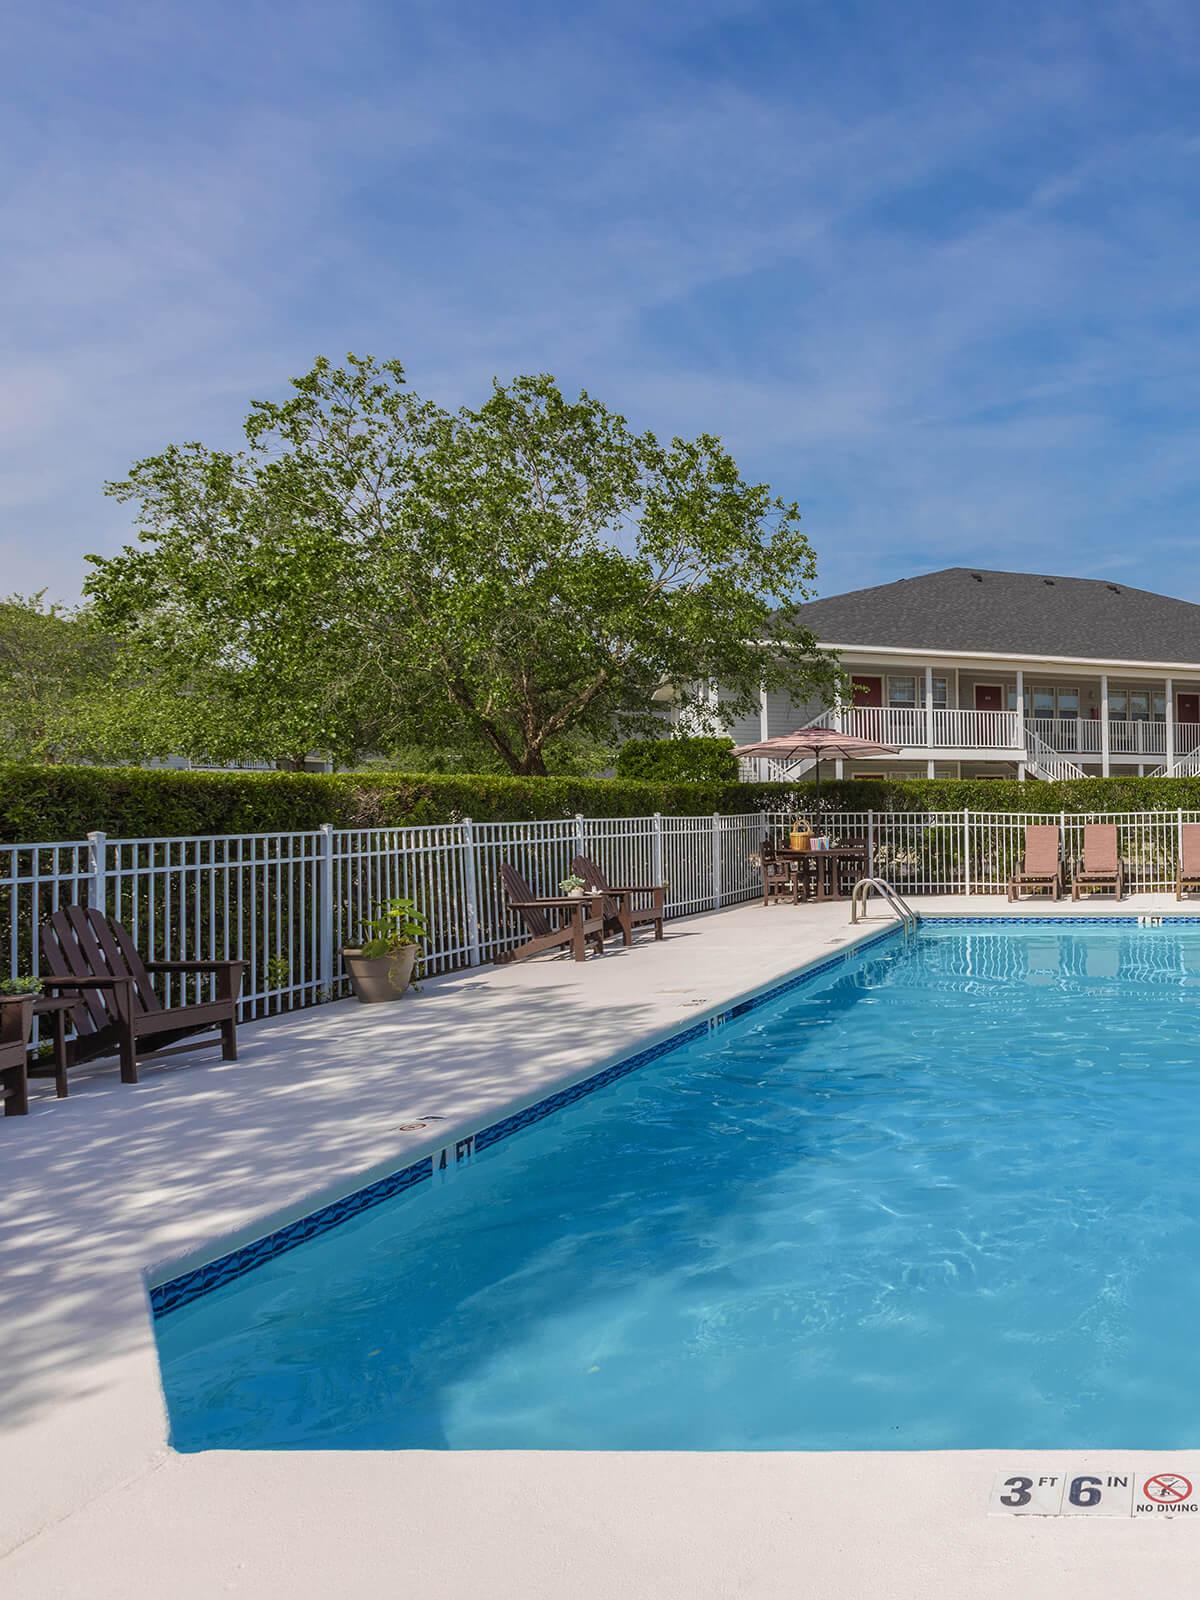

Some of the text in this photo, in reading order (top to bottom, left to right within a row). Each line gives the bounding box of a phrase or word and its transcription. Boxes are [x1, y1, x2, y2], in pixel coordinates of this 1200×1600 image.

[456, 1135, 475, 1162] FT
[999, 1475, 1129, 1508] 3 FT 6 IN
[1136, 1503, 1199, 1513] NO DIVING
